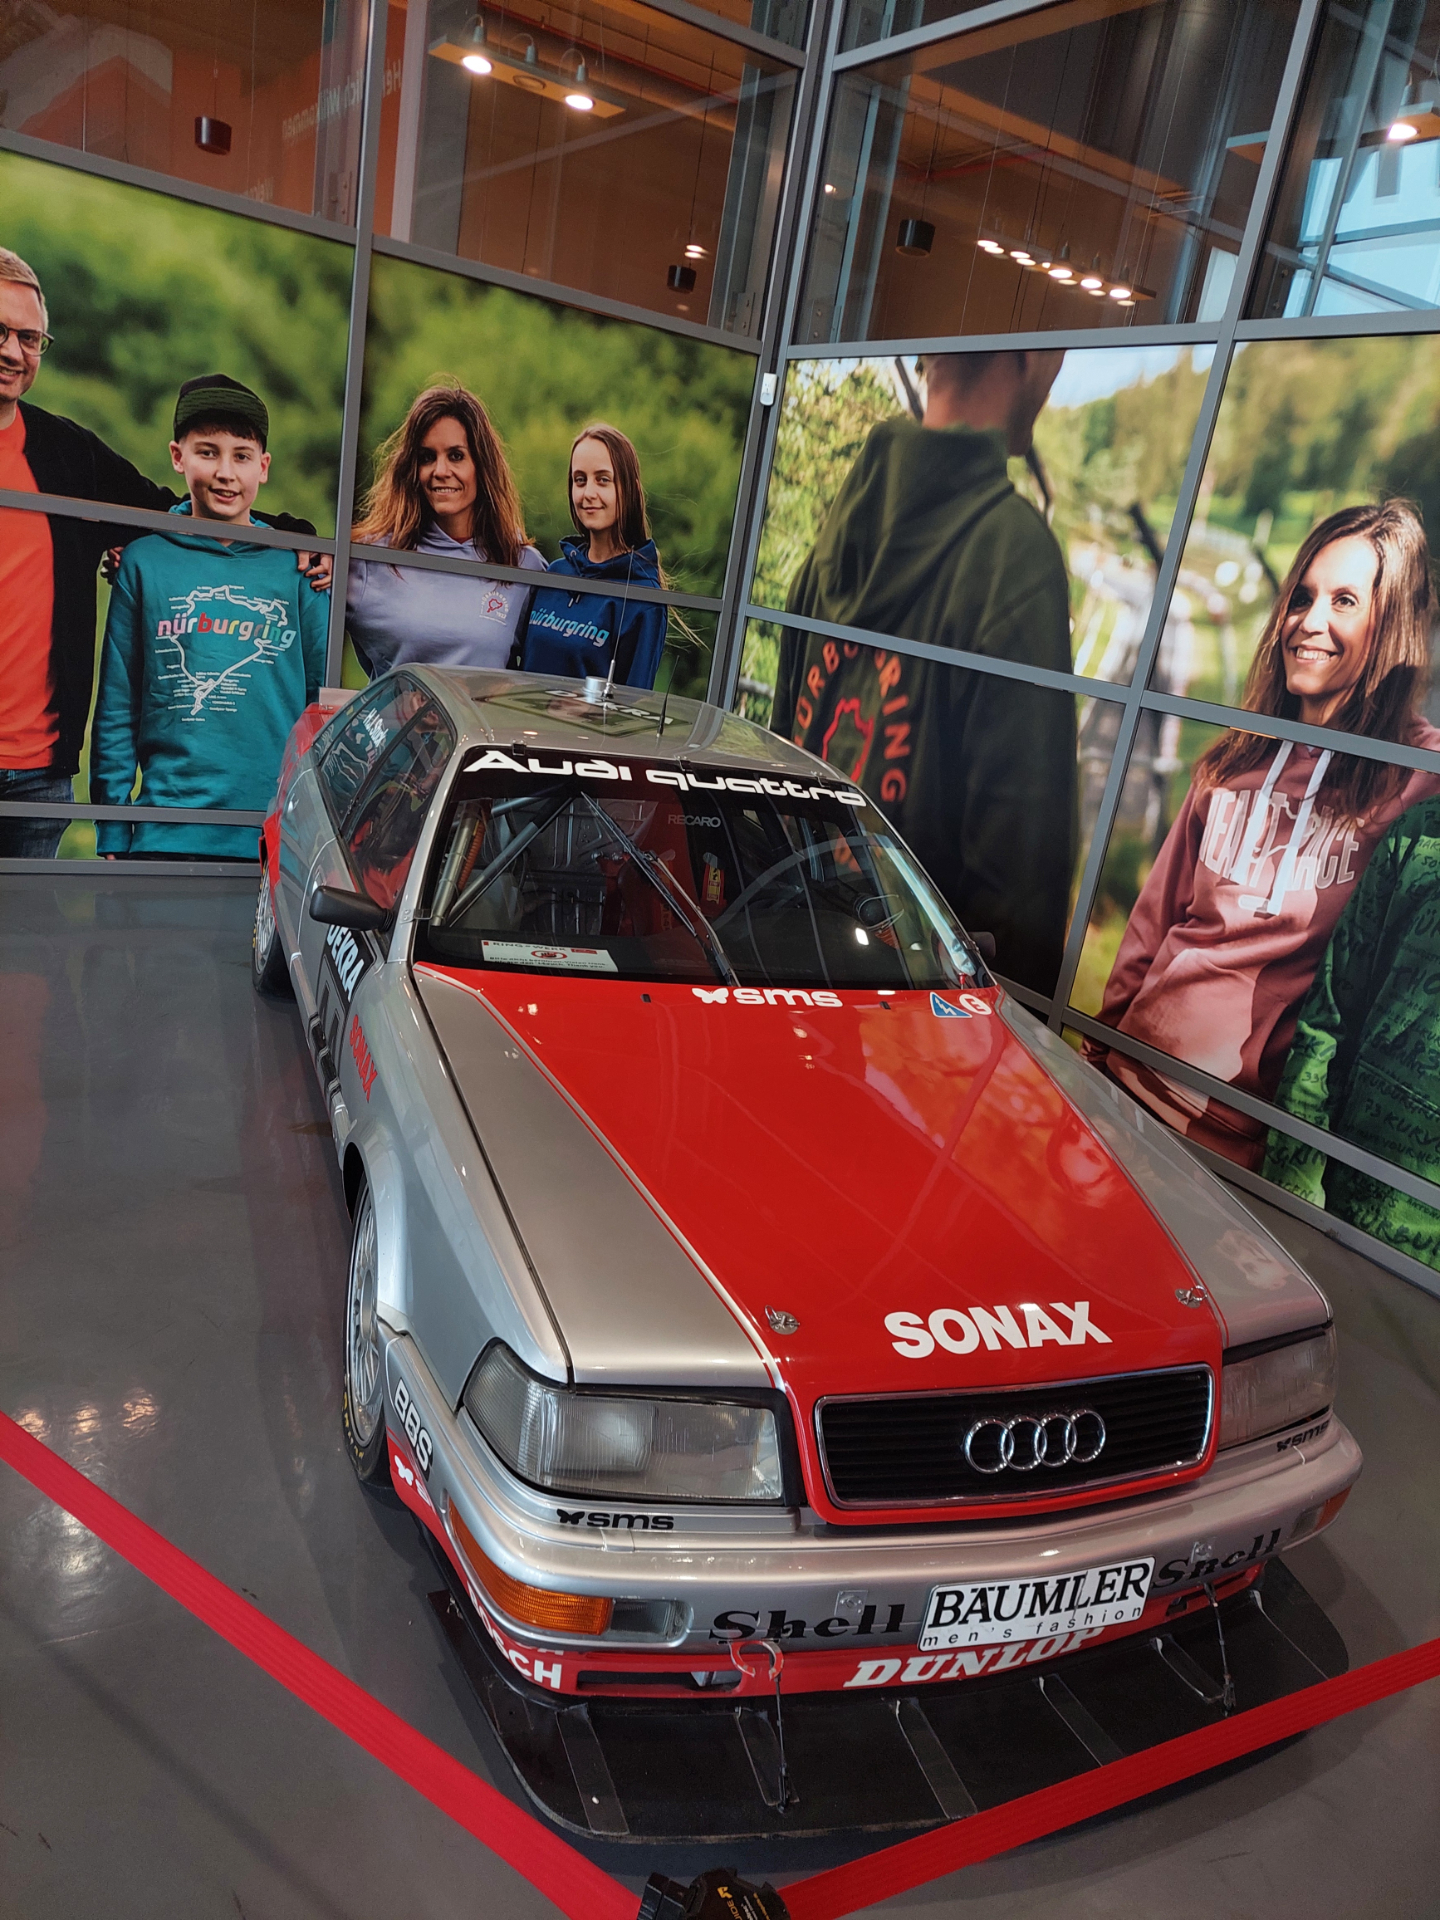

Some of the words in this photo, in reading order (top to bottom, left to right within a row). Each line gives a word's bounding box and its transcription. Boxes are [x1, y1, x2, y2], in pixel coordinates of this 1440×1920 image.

[158, 612, 297, 648] nürburgring
[528, 607, 610, 648] nürburgring
[463, 750, 633, 782] Audi
[645, 768, 867, 807] quattro
[668, 814, 721, 828] RECARO
[733, 988, 843, 1007] sms
[350, 1014, 378, 1103] SONAX
[884, 1301, 1113, 1359] SONAX
[395, 1379, 433, 1471] BBS
[1291, 1420, 1329, 1447] sms
[586, 1512, 674, 1530] sms
[1152, 1528, 1281, 1589] Shell
[927, 1562, 1150, 1629] BÄUMLER
[1036, 1605, 1142, 1635] fashion
[467, 1581, 562, 1690] BOSCH
[709, 1603, 905, 1640] Shell
[843, 1627, 1104, 1687] DUNLOP
